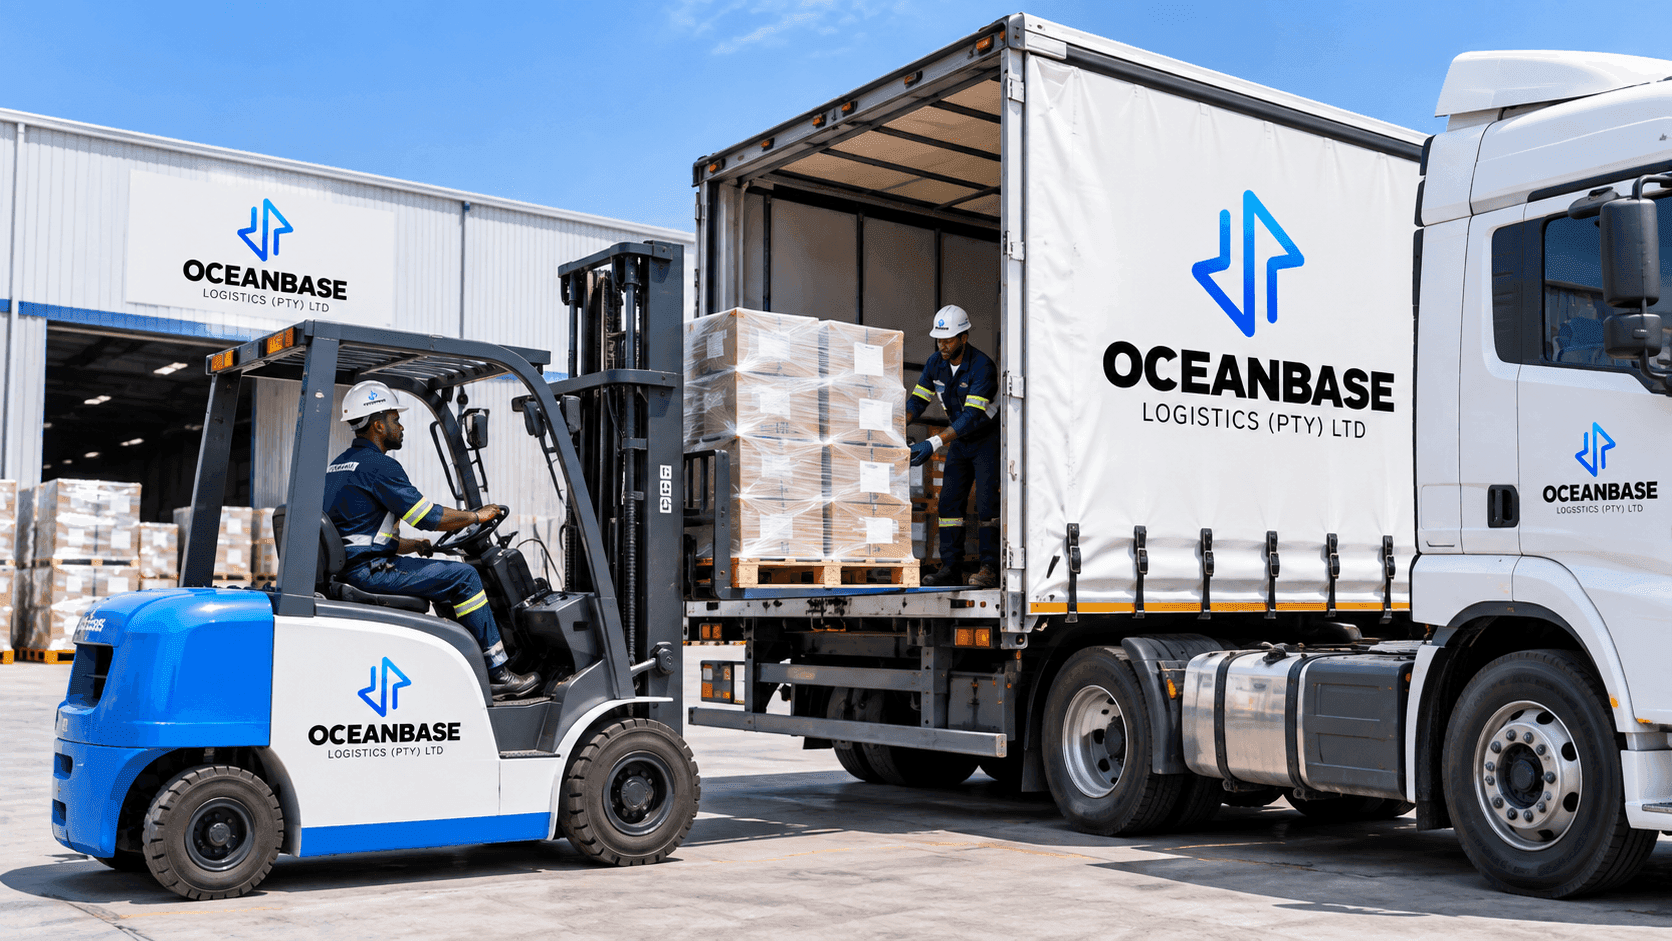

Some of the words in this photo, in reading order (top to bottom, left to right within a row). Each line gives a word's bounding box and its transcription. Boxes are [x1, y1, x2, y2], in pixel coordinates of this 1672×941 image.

[183, 259, 347, 300] OCEANBASE
[203, 289, 266, 305] LOGISTICS
[271, 296, 304, 311] (PTY)
[310, 298, 329, 312] LTD
[1103, 341, 1395, 412] OCEANBASE
[1143, 402, 1260, 431] LOGISTICS
[1268, 412, 1323, 437] (PTY)
[1333, 419, 1366, 438] LTD
[1543, 482, 1658, 503] OCEANBASE
[1602, 504, 1625, 514] (PTY)
[1628, 504, 1644, 513] LTD
[308, 722, 462, 746] OCEANBASE
[328, 748, 387, 759] LOGISTICS
[391, 747, 421, 758] (PTY)
[426, 746, 443, 756] LTD
